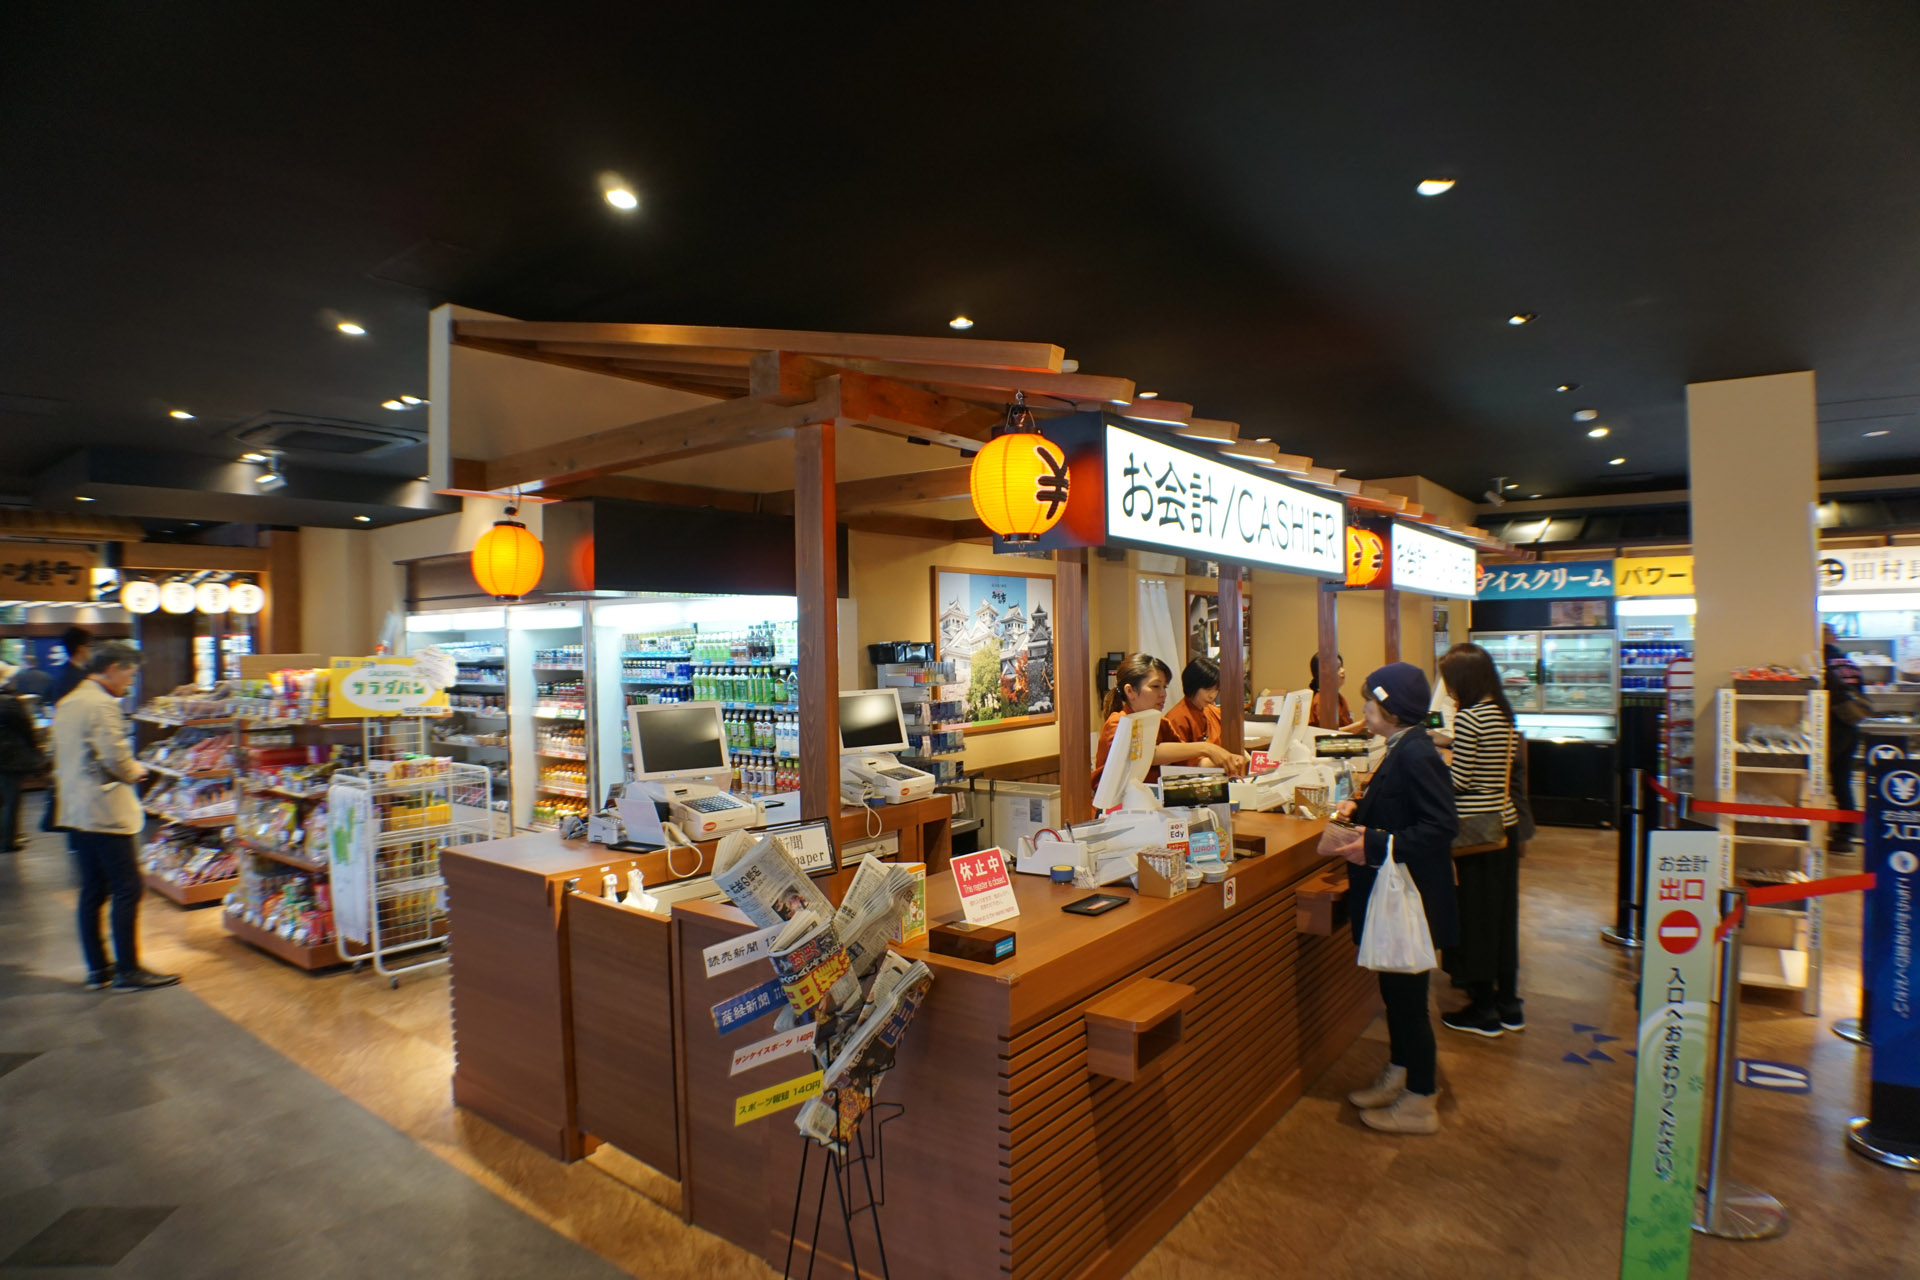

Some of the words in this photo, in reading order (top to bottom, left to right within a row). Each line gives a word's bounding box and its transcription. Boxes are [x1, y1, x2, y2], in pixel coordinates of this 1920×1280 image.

[352, 680, 425, 695] サラダパン
[960, 855, 1000, 881] 休止中
[1658, 855, 1710, 872] お会計
[1659, 877, 1705, 901] 出口
[706, 941, 759, 968] 読売新聞
[721, 991, 771, 1027] 産経新聞
[734, 1037, 793, 1066] サンケイスポーツ
[1655, 967, 1686, 1182] 入口へおまわりください
[793, 1080, 821, 1096] 140円
